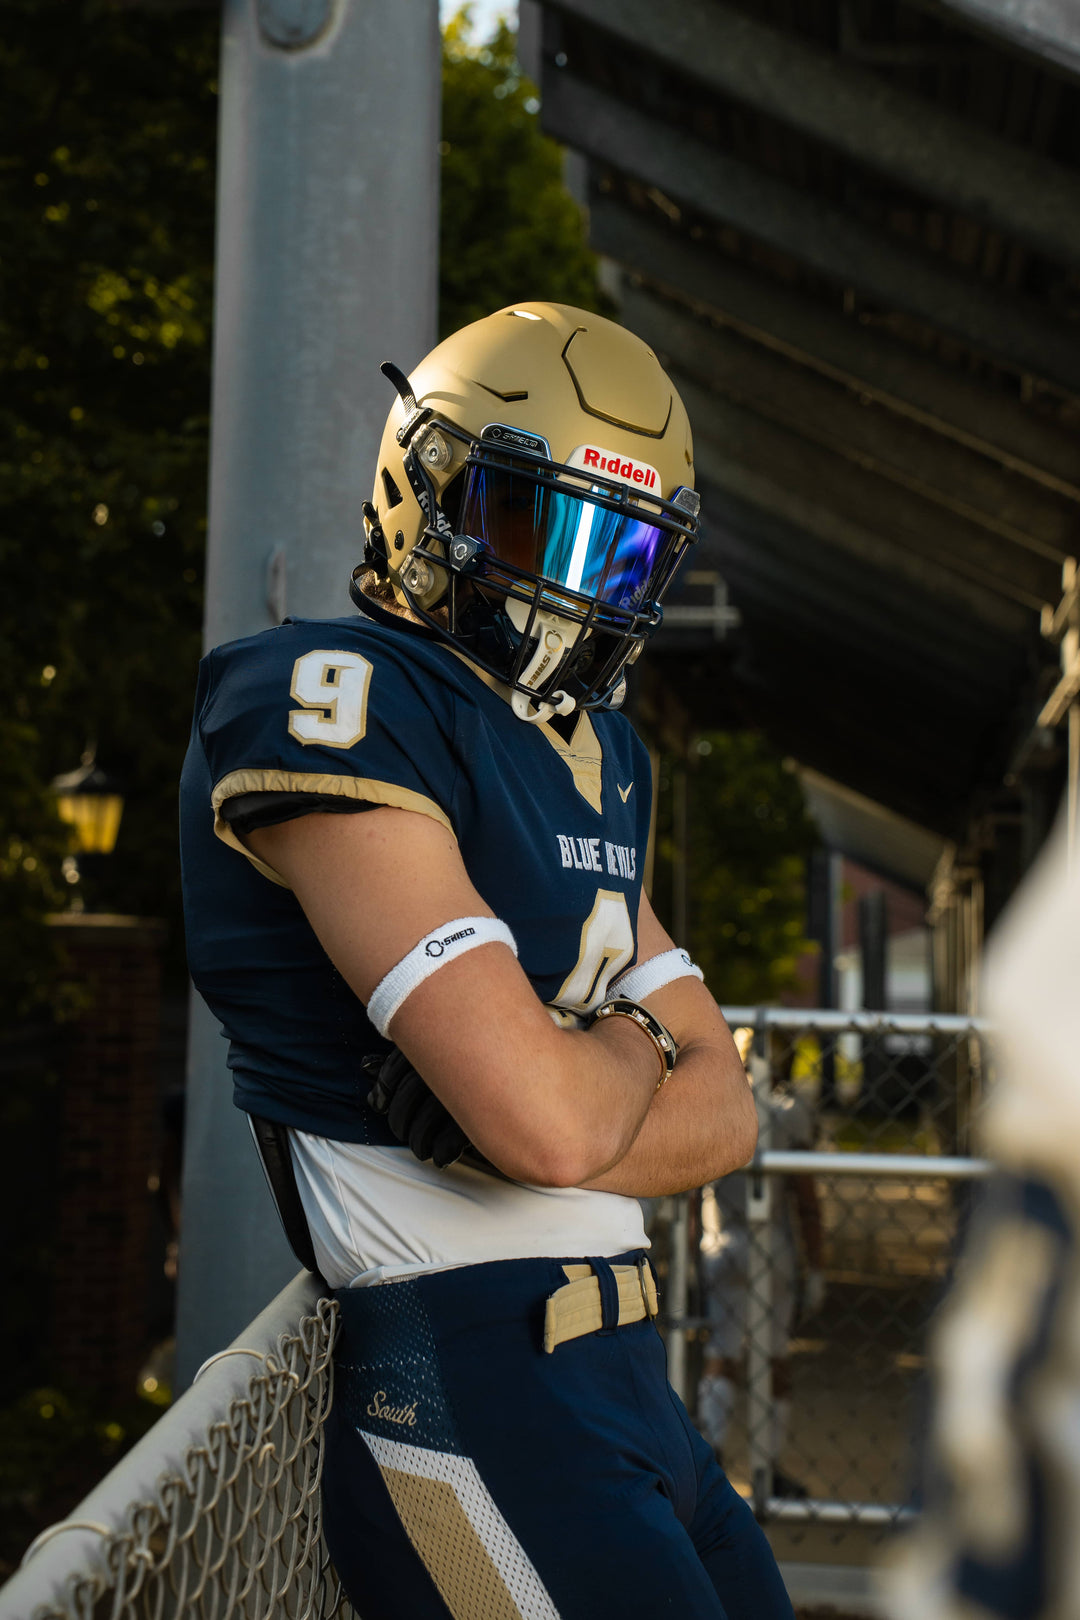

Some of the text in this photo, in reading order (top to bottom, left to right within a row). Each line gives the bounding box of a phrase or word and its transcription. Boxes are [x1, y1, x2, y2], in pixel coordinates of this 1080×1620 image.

[583, 448, 656, 488] Riddell
[526, 654, 551, 687] SHIEL
[288, 649, 374, 750] 9
[556, 834, 637, 881] BLUE DEVILS
[444, 927, 476, 946] SHIELD
[367, 1390, 418, 1426] South
